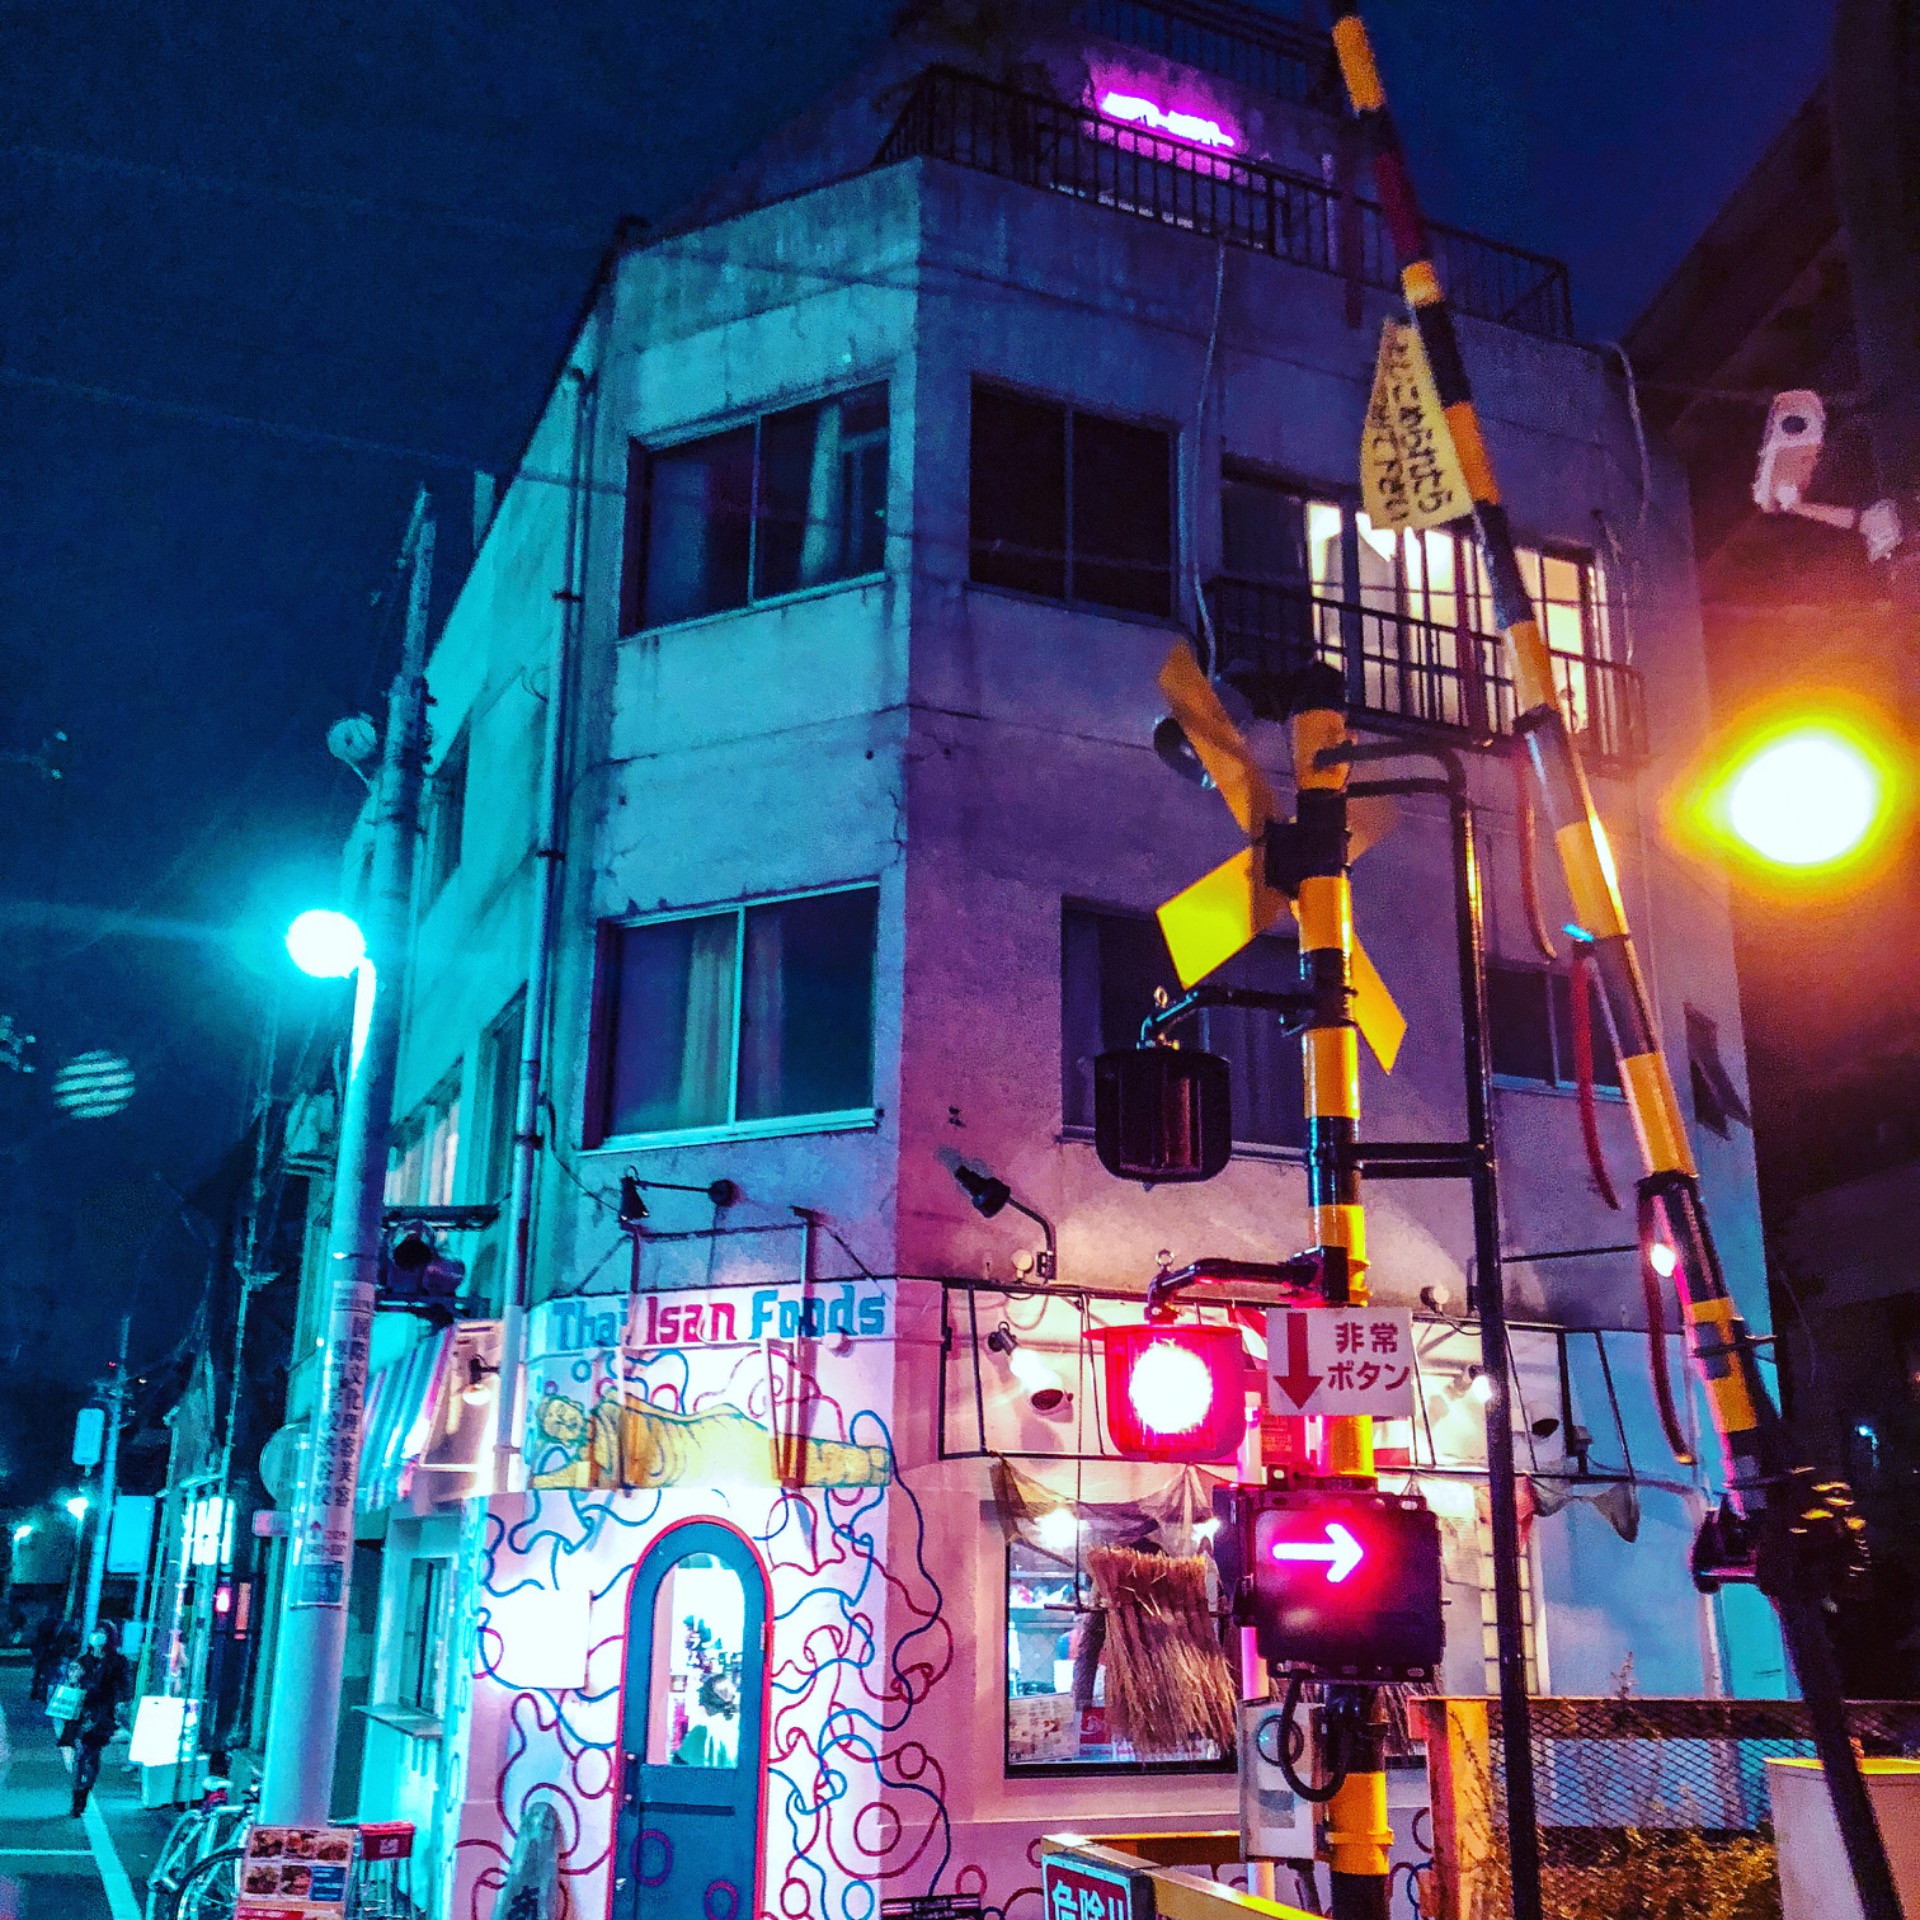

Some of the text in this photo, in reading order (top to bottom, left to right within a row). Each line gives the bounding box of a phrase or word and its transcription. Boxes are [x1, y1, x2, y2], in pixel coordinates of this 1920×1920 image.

[553, 1284, 886, 1351] Thai Isan Foods
[1334, 1321, 1399, 1354] 非常
[1327, 1359, 1411, 1391] ボタン
